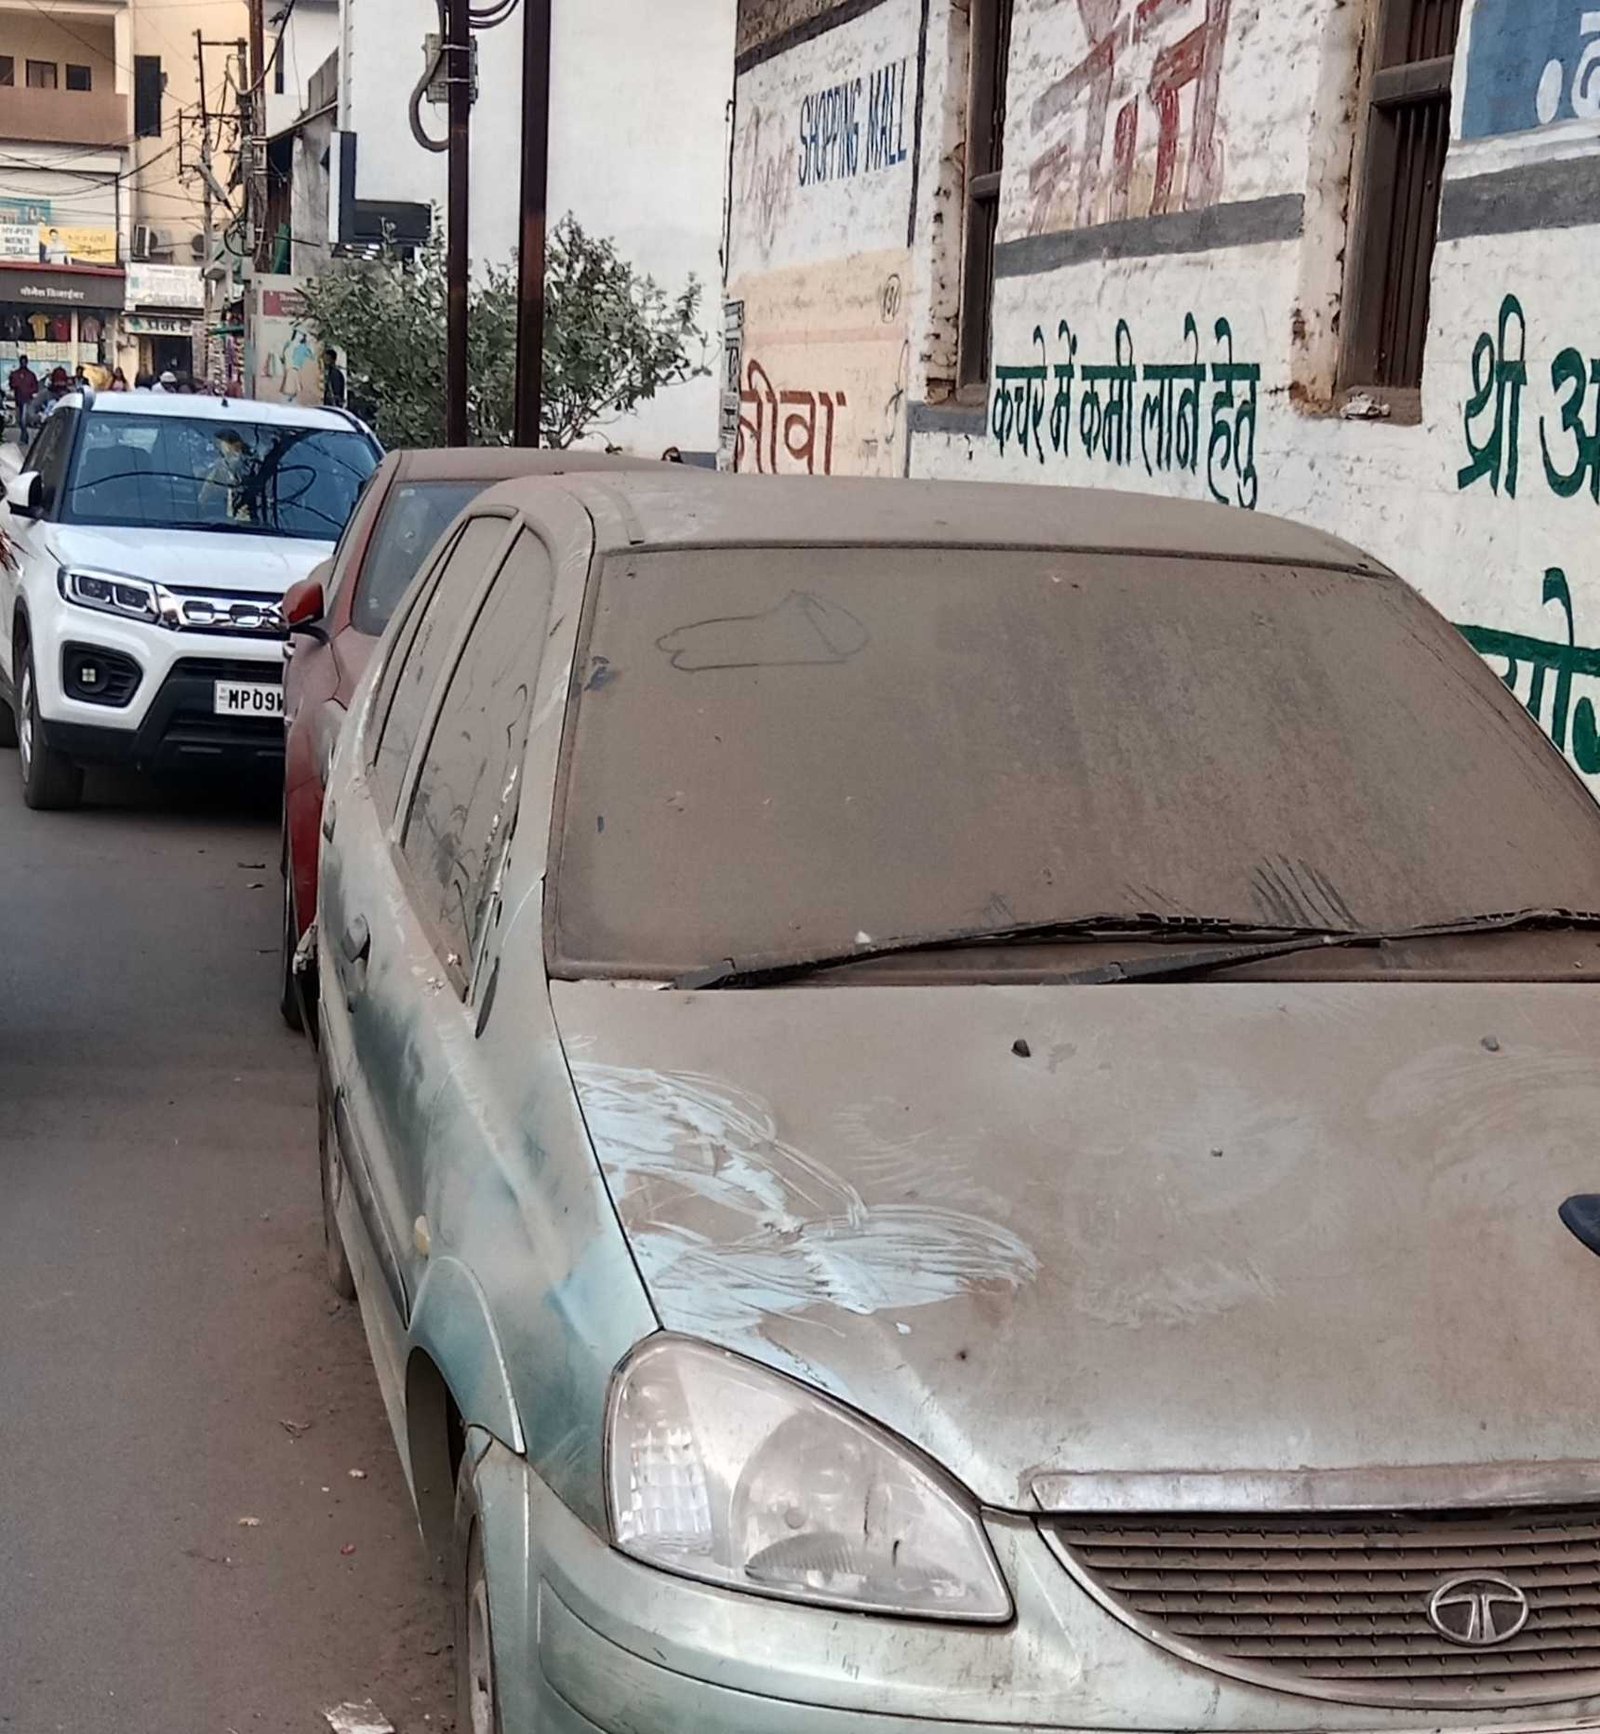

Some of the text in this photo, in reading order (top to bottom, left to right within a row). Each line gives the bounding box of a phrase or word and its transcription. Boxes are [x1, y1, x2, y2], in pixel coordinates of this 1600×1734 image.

[799, 78, 861, 187] SHOPPING
[865, 59, 907, 173] MALL
[992, 312, 1261, 511] कचरे में कमी लाने हेतु
[1457, 293, 1528, 500] श्री
